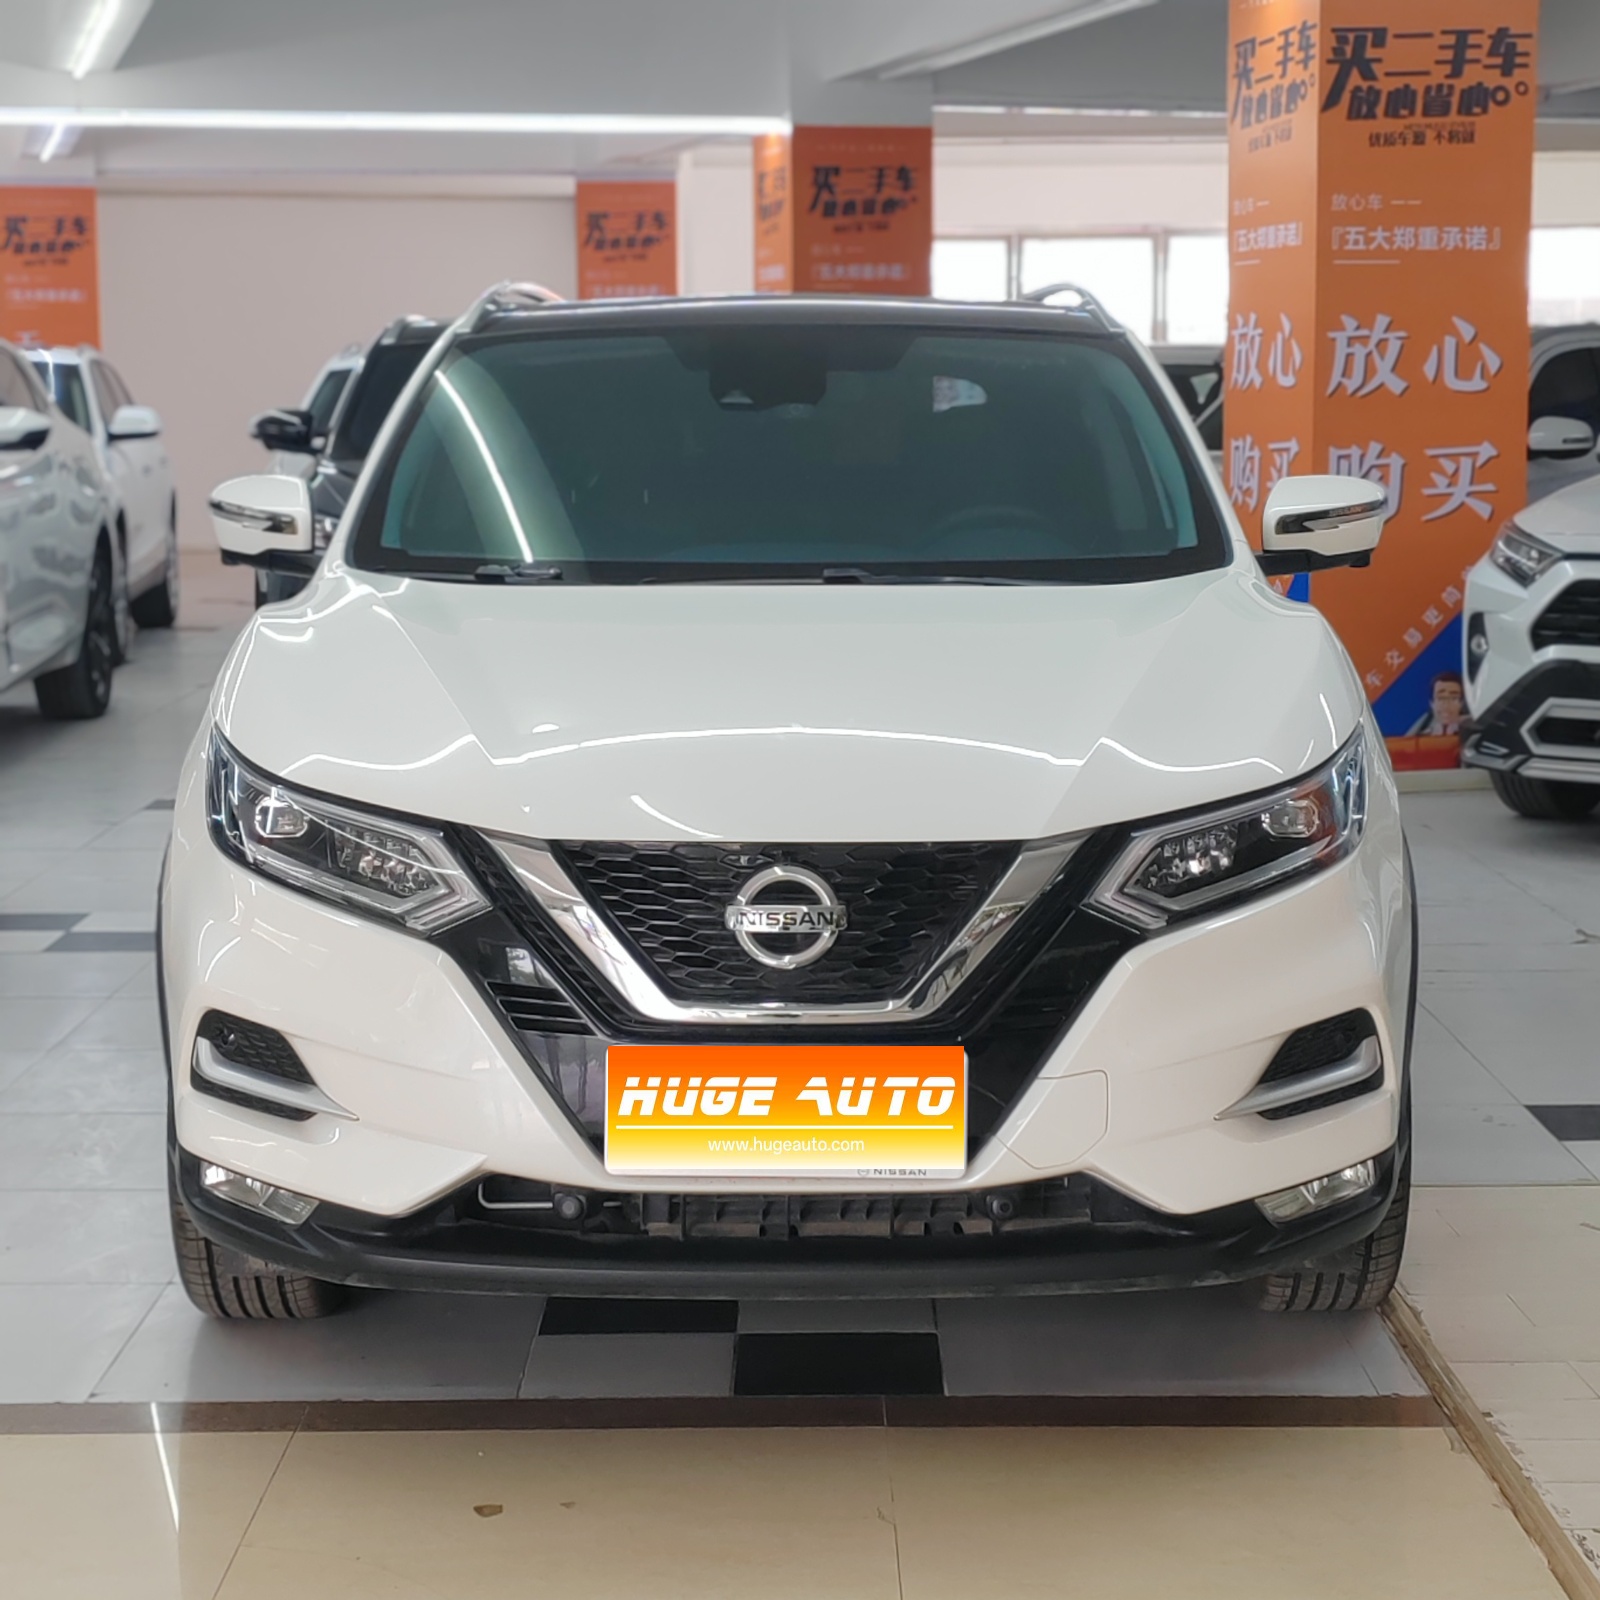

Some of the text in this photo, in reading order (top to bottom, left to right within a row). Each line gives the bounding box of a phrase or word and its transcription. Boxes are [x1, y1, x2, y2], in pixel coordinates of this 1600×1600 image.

[1231, 20, 1317, 124] 买二手车
[1321, 27, 1533, 113] 买二手车
[1231, 312, 1302, 390] 放心
[1326, 313, 1503, 397] 放心
[738, 911, 834, 927] NISSAN
[873, 1168, 927, 1176] NISSAN
